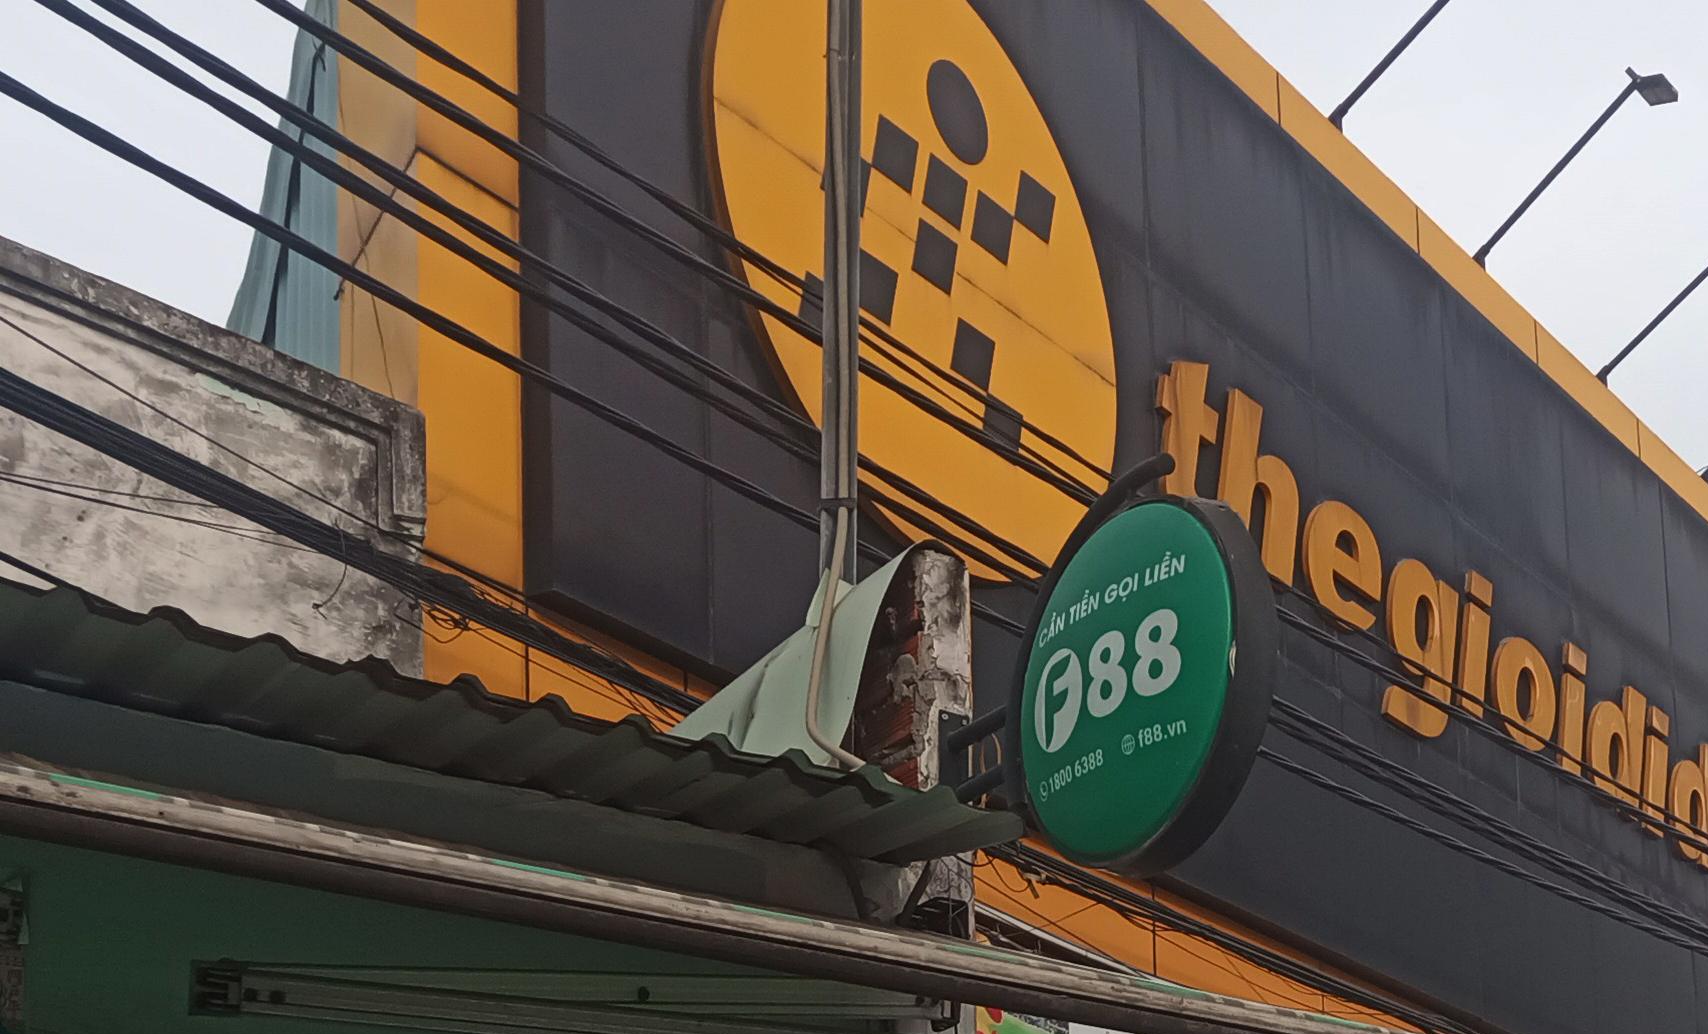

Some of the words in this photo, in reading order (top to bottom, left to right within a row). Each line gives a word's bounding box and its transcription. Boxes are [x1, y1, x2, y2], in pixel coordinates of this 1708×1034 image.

[1068, 588, 1099, 626] TIỀN
[1105, 572, 1139, 604] GỌI
[1144, 550, 1186, 586] LIỀN
[1137, 716, 1188, 750] f88.vn
[1048, 764, 1073, 794] 1800
[1074, 748, 1104, 786] 6388
